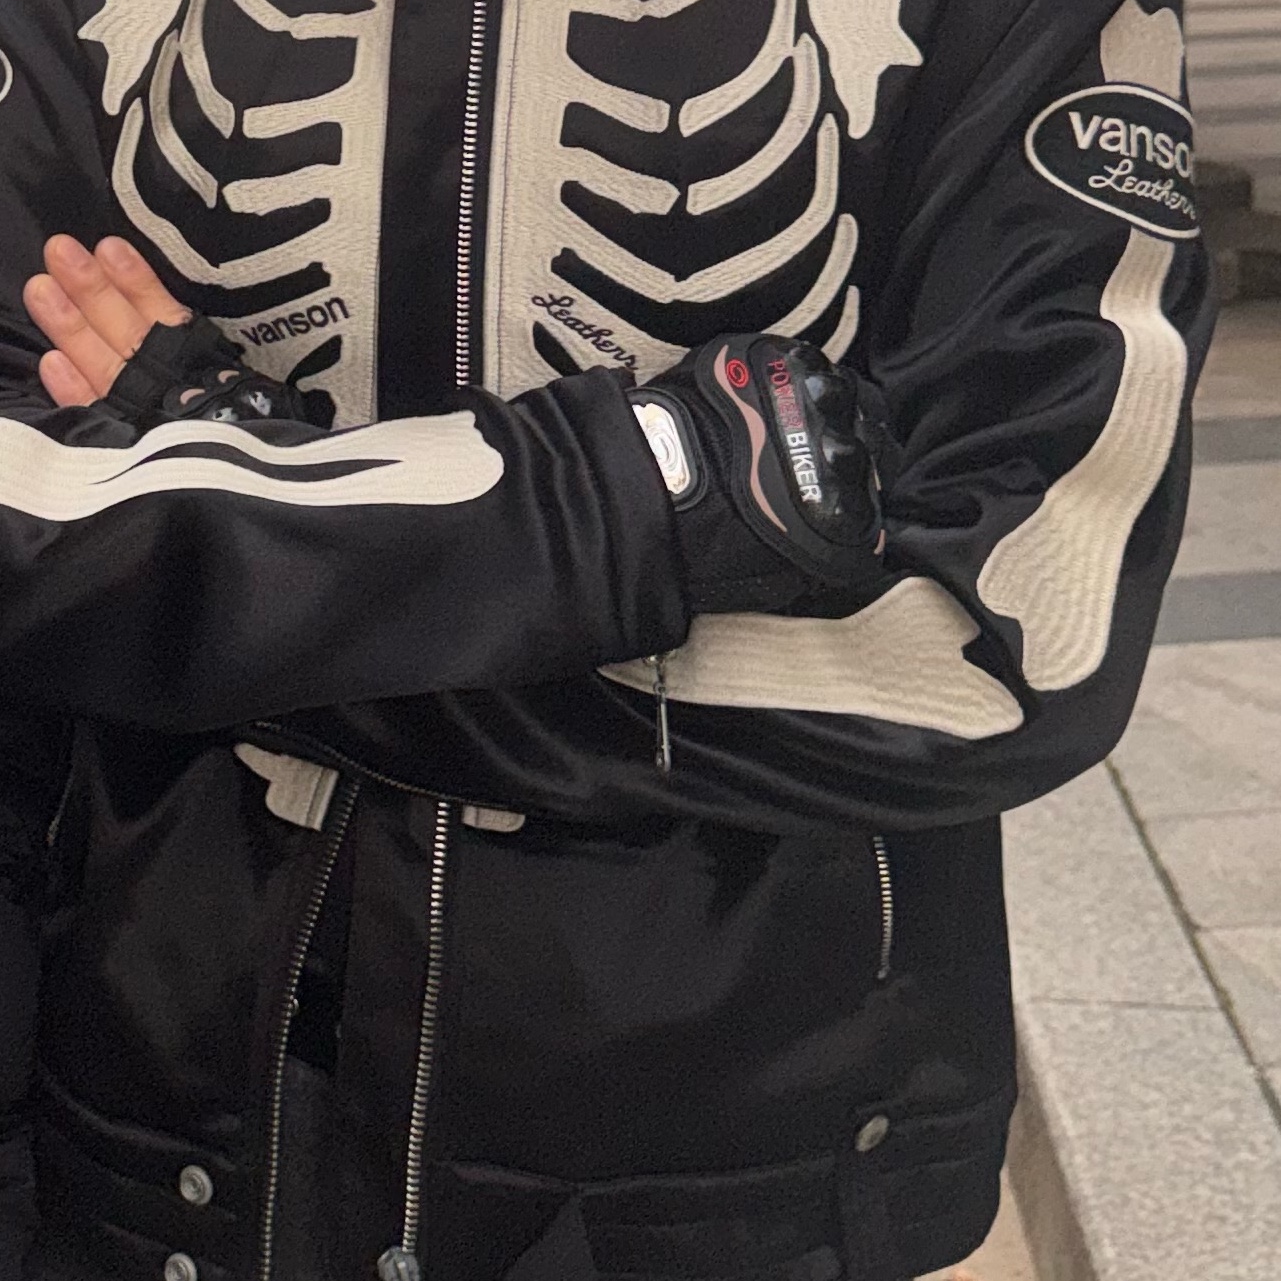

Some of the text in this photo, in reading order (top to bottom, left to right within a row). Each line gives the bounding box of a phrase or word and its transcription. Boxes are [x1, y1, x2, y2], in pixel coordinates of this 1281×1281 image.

[1067, 110, 1194, 179] vanso
[239, 296, 351, 347] vanson
[531, 293, 640, 371] Leathers
[786, 431, 822, 504] BIKER
